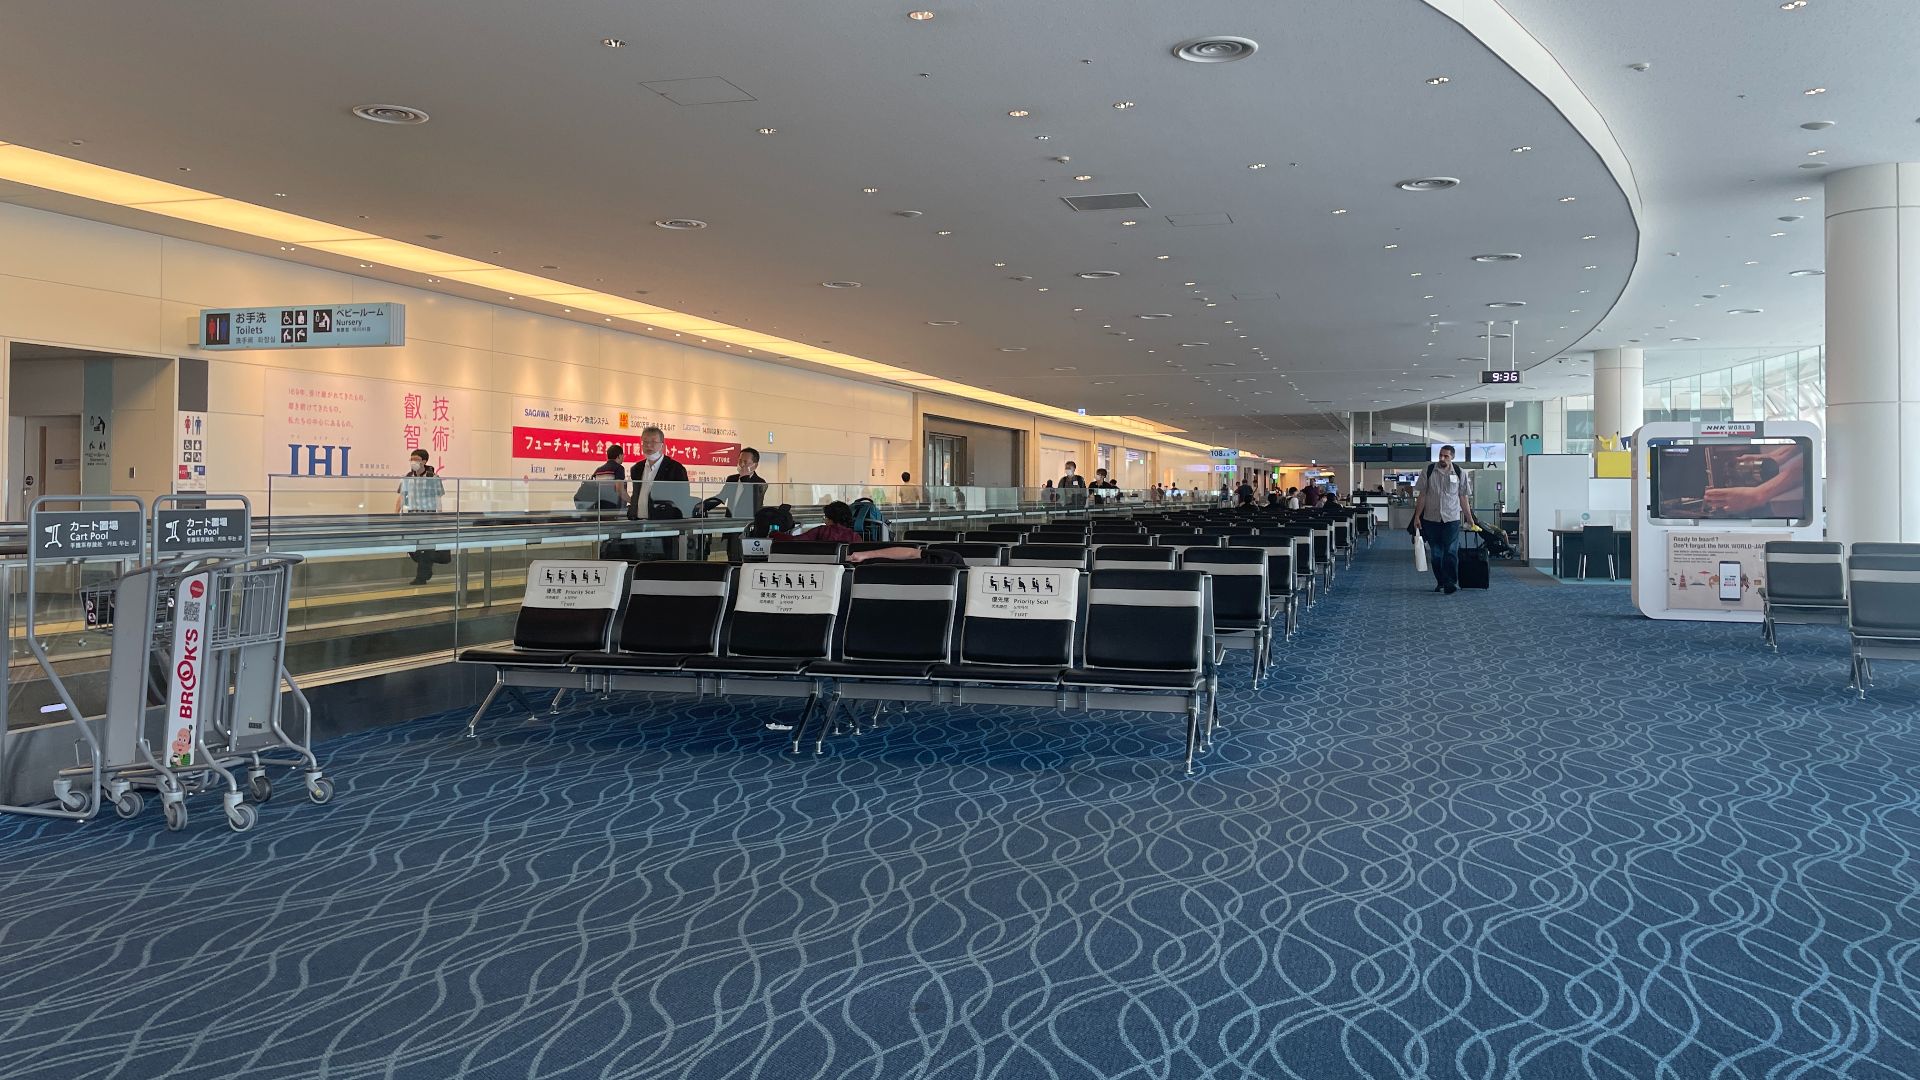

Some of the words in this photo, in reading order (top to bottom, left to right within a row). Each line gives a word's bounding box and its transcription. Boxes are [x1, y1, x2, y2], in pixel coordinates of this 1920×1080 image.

[235, 311, 267, 324] お手洗
[336, 307, 384, 318] ベビールーム
[336, 319, 363, 328] Nursery
[235, 326, 264, 335] Toilets
[1492, 372, 1518, 382] 9:36
[524, 408, 550, 418] SAGAWA
[288, 443, 352, 476] IHI
[69, 520, 119, 531] カート置場
[186, 517, 228, 527] カート置場
[69, 531, 88, 541] Cart
[90, 531, 109, 540] Pool
[186, 528, 202, 536] Cart
[203, 527, 220, 535] Pool
[1013, 598, 1035, 606] Priority
[176, 628, 199, 719] BROOK'S
